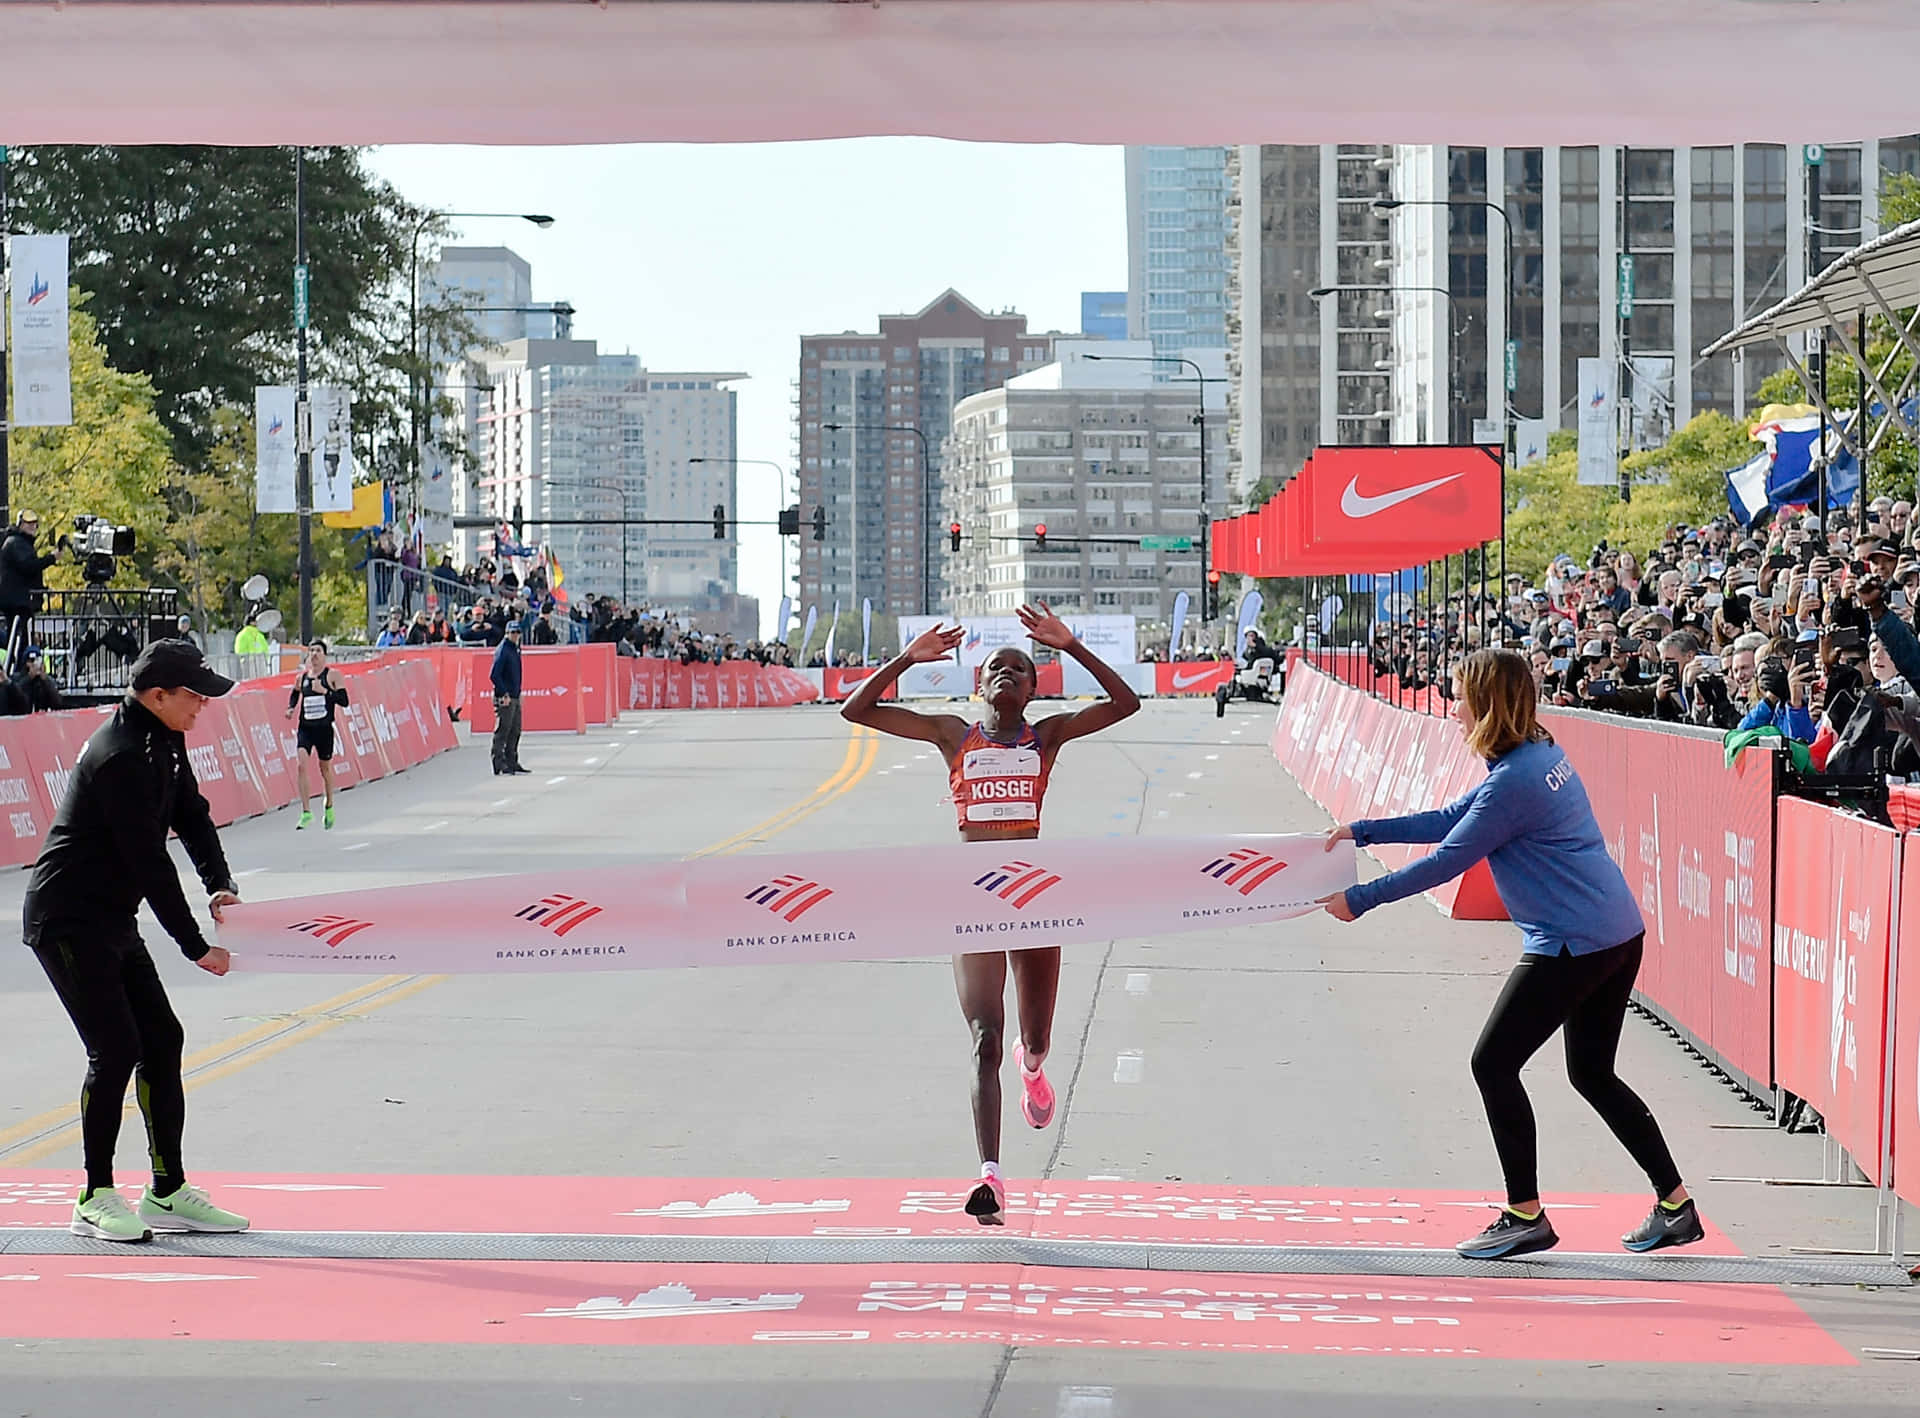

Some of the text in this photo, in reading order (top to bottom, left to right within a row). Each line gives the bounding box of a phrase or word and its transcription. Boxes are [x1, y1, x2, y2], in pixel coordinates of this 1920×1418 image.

[971, 780, 1033, 800] KOSGEI
[1183, 909, 1220, 918] BANK
[1247, 901, 1309, 911] AMERICA
[955, 918, 1085, 934] BANK OF AMERICA
[727, 931, 856, 947] BANK OF AMERICA
[496, 945, 626, 959] BANK OF AMERICA
[1152, 1195, 1420, 1208] America
[861, 1290, 1339, 1311] Chicago
[869, 1281, 1474, 1303] Bank of America
[857, 1300, 1460, 1326] Marathon
